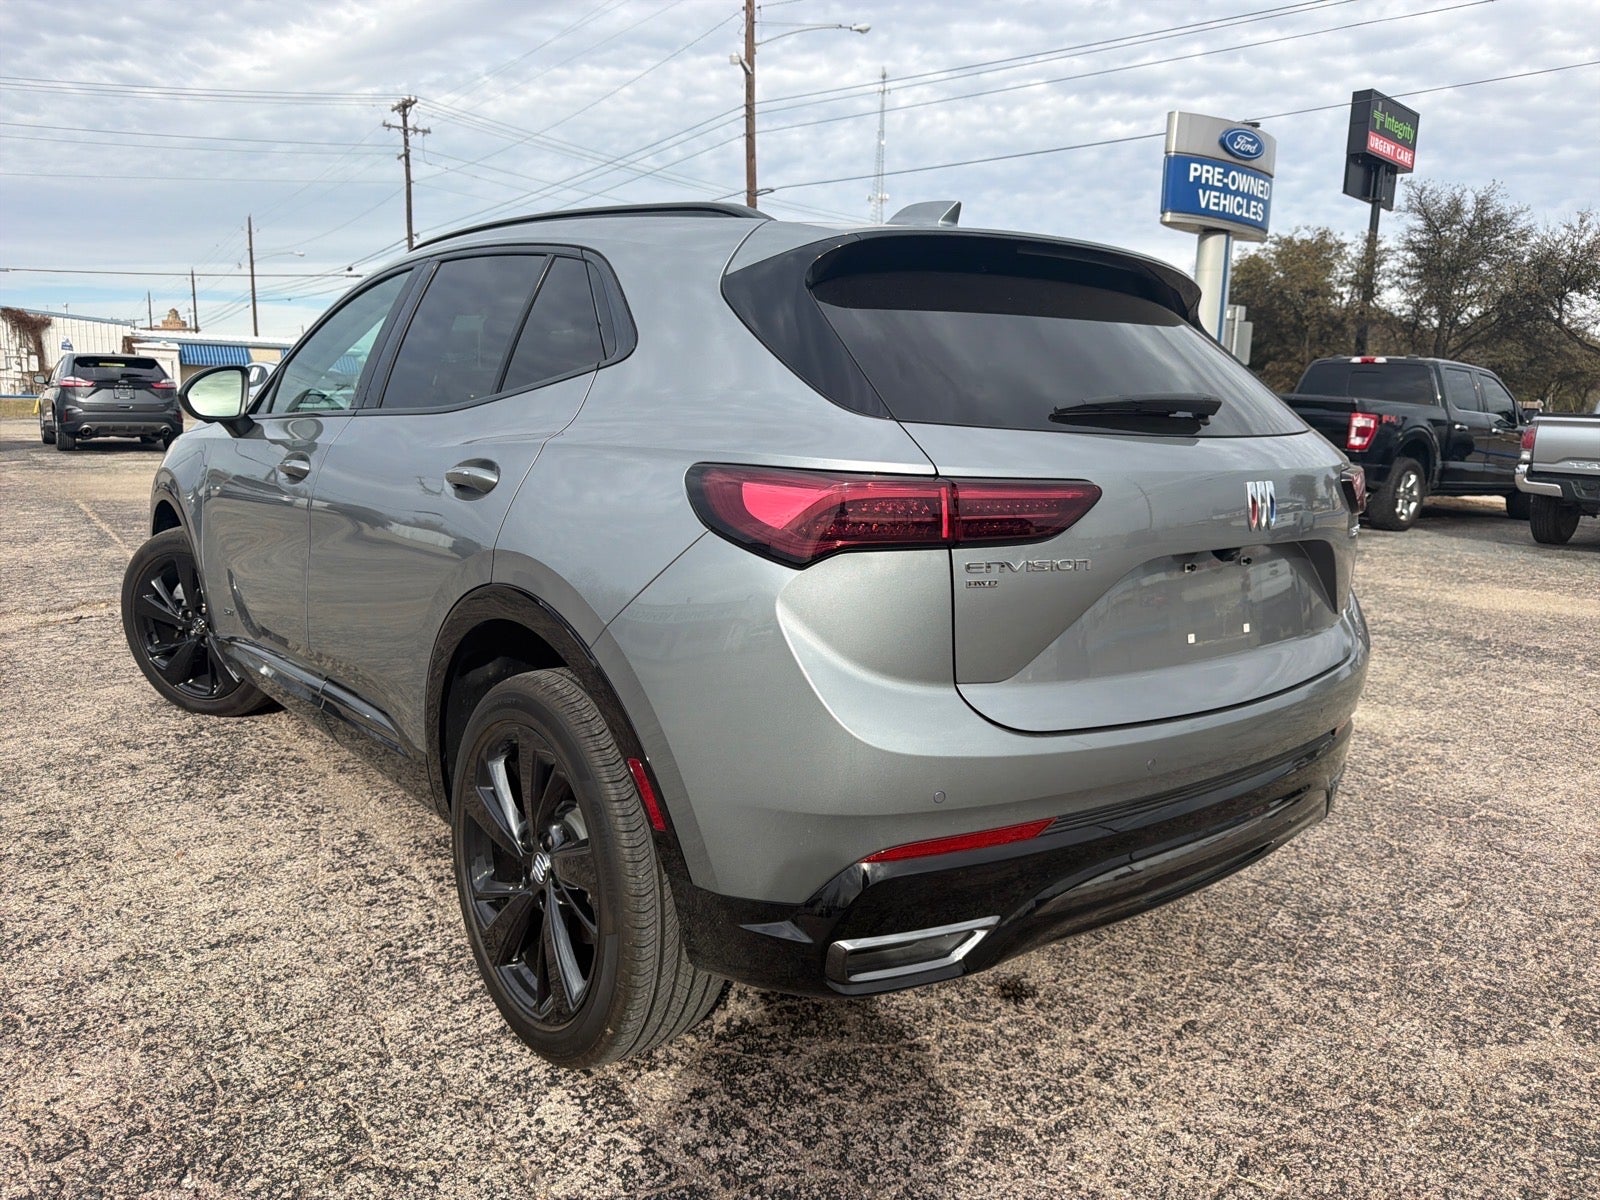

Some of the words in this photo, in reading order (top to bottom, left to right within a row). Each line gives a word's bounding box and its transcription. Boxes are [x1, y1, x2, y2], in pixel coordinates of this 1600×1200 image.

[1384, 111, 1414, 144] Integrity
[1233, 134, 1259, 154] Ford
[1369, 135, 1396, 157] URGENT
[1396, 148, 1413, 165] CARE
[1188, 162, 1271, 200] PRE-OWNED
[1198, 188, 1264, 222] VEHICLES
[966, 580, 998, 588] AWD
